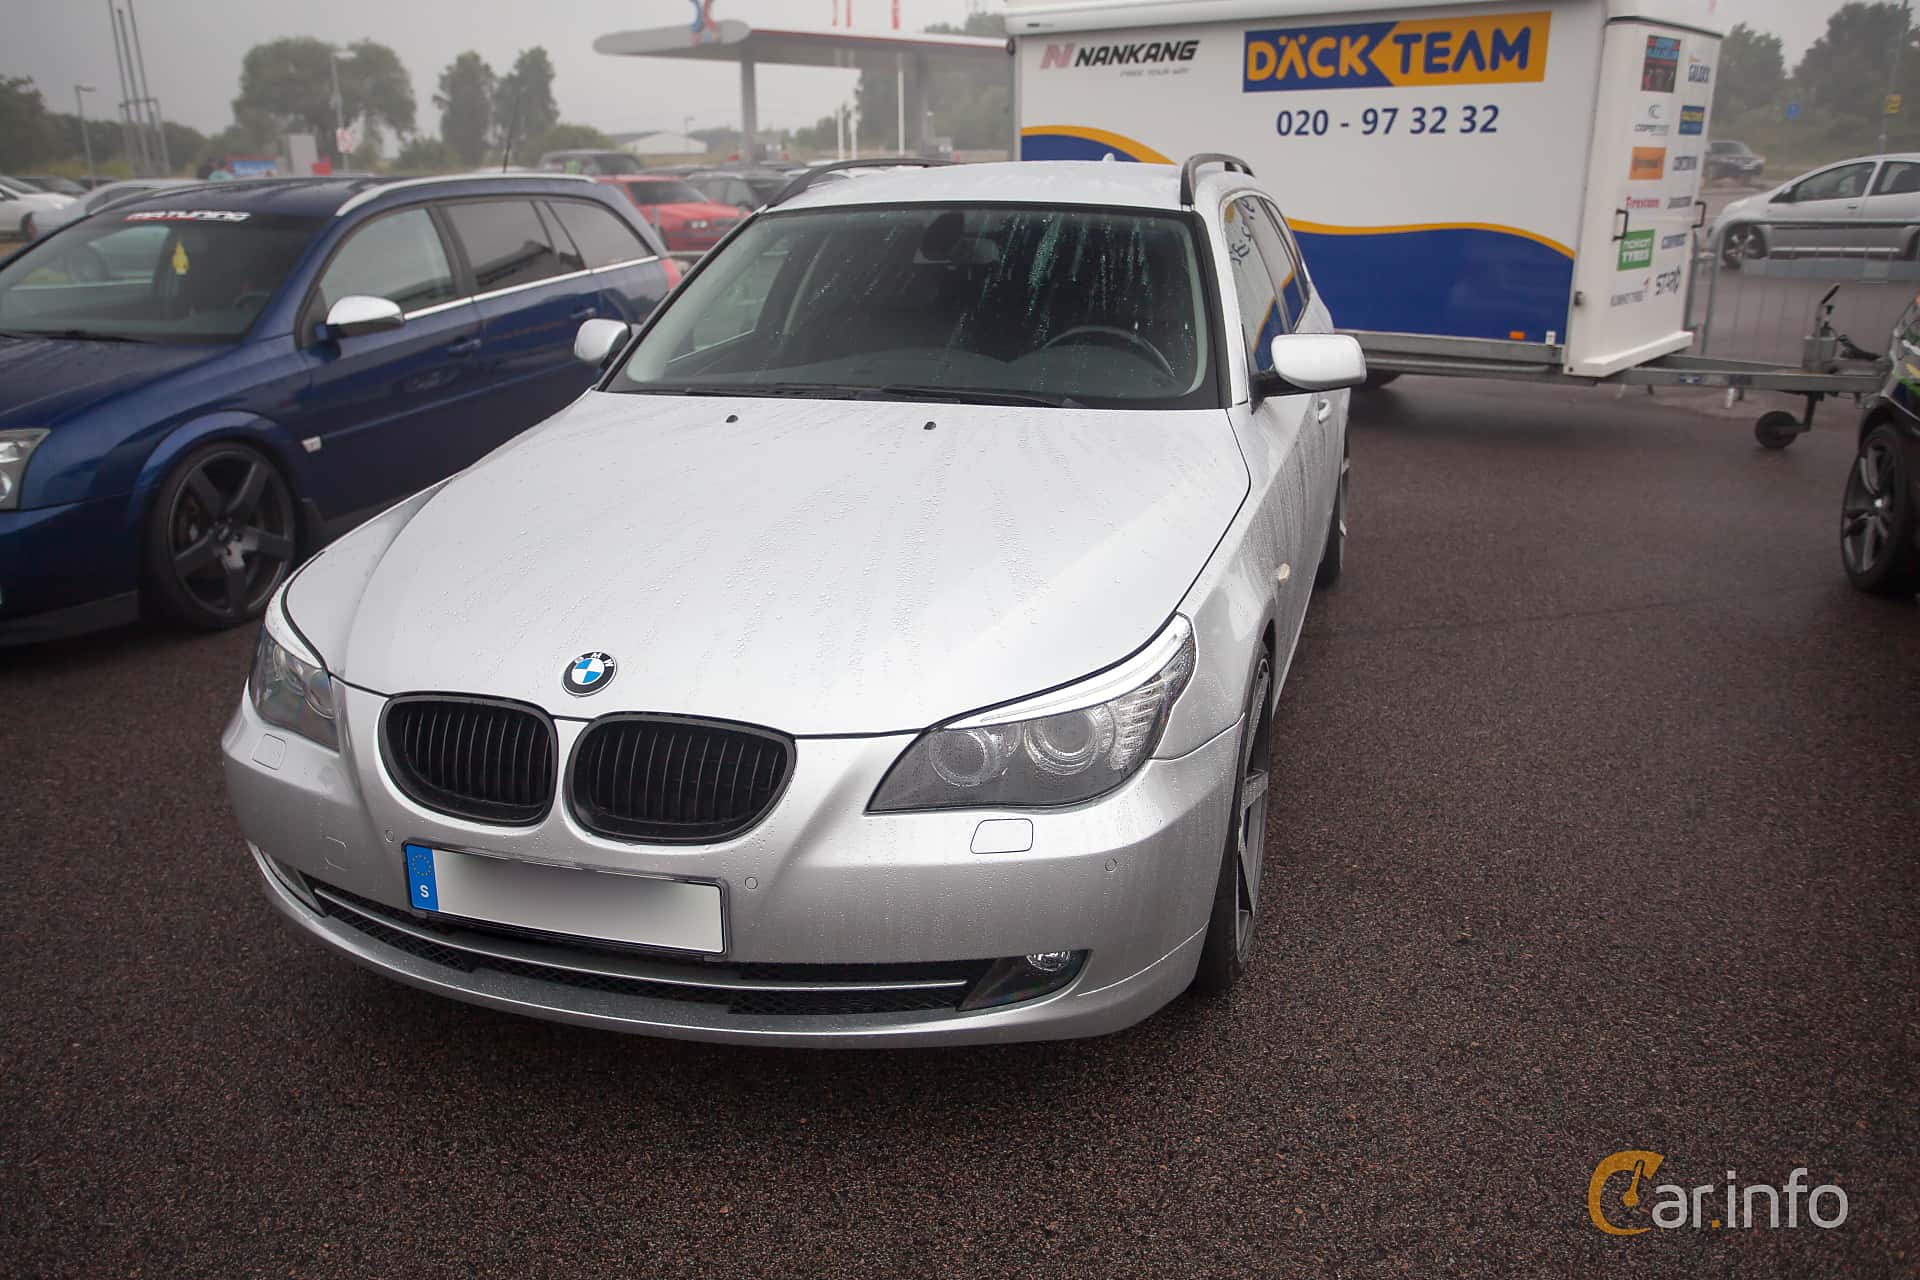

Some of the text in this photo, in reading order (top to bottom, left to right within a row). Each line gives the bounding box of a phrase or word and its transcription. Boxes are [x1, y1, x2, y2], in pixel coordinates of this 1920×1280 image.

[1074, 39, 1200, 67] NANKANG
[1247, 27, 1531, 81] DÄCK TEAM
[1276, 108, 1329, 138] 020
[1360, 107, 1399, 137] 97
[1409, 105, 1447, 135] 32
[1458, 103, 1500, 134] 32
[419, 884, 431, 899] S
